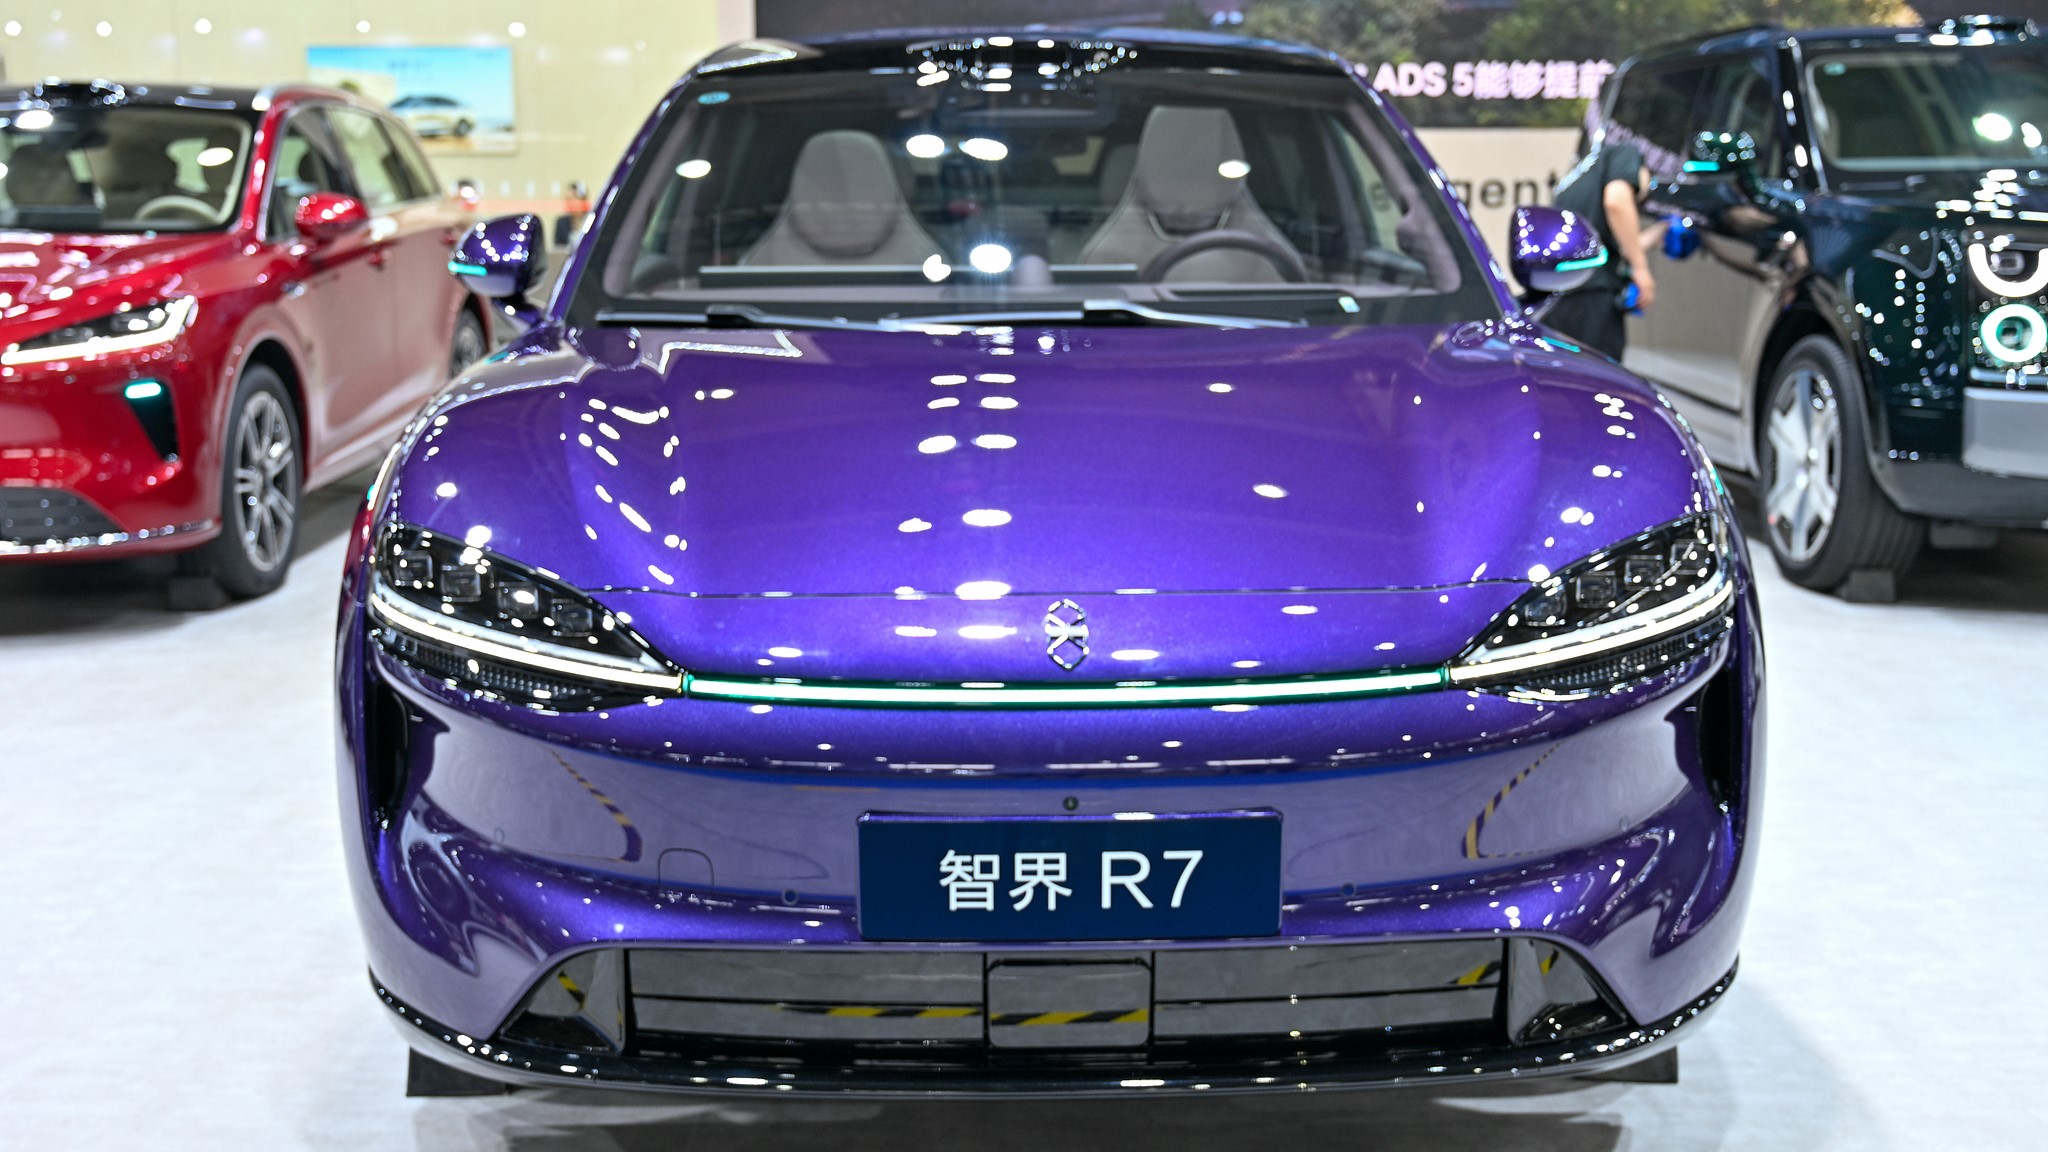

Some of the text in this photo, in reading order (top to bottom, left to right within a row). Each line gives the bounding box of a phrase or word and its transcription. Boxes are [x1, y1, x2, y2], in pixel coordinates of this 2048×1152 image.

[1373, 60, 1448, 98] ADS
[939, 849, 1204, 912] 智界 R7
